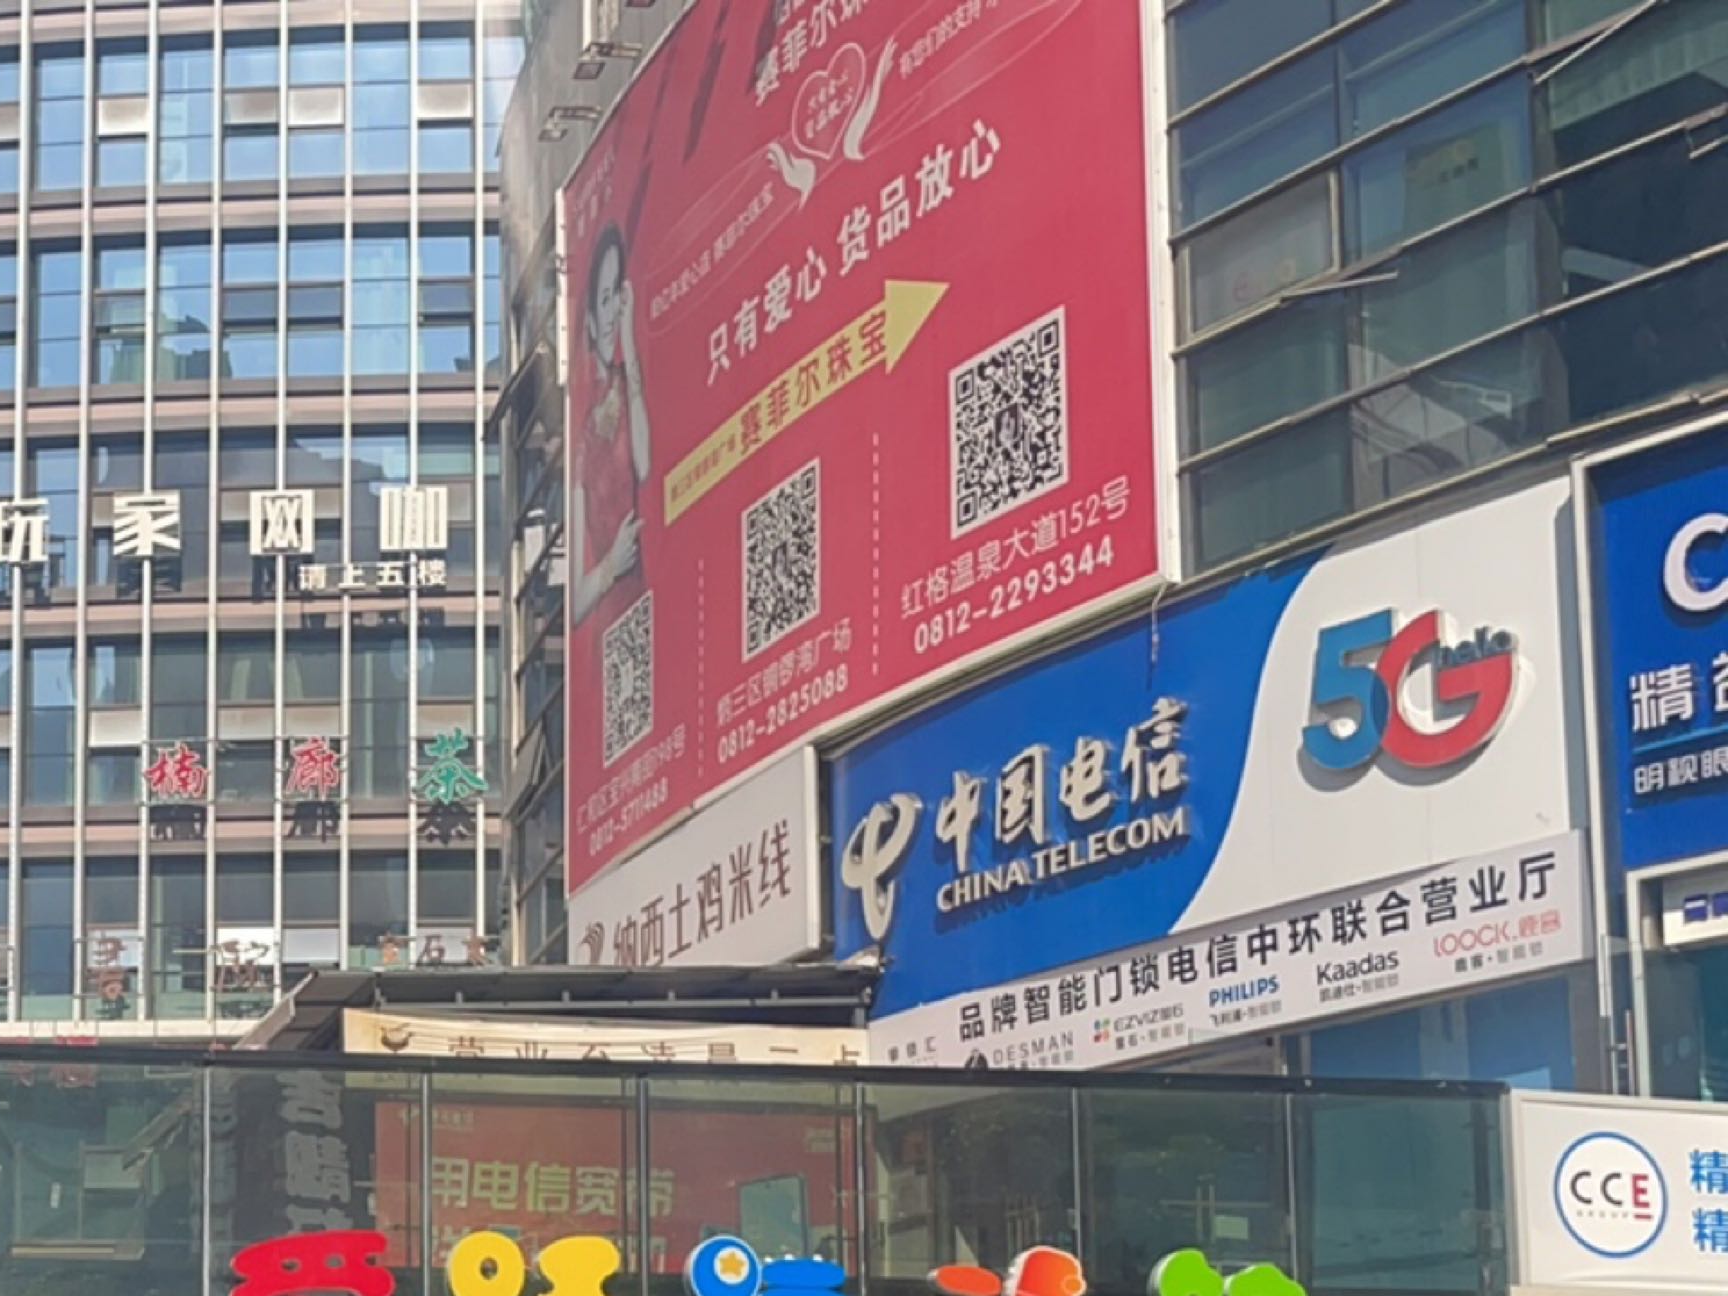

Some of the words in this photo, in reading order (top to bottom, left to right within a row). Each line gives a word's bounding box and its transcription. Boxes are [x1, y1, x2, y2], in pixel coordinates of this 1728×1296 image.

[706, 246, 828, 385] 只有爱心
[835, 118, 1002, 276] 货品放心
[739, 310, 889, 456] 赛菲尔珠宝
[298, 561, 448, 592] 请上五楼
[900, 475, 1131, 619] 红格温泉大道152号
[914, 537, 1116, 655] 0812-2293344
[934, 696, 1190, 872] 中国电信
[936, 864, 1027, 913] CHINA
[1029, 812, 1190, 882] TELECOM
[958, 850, 1556, 1043] 品牌智能门锁电信中环联合营业厅
[1208, 974, 1280, 1008] PHILIPS
[1315, 950, 1400, 986] Kaadas
[1570, 1170, 1651, 1209] CCE
